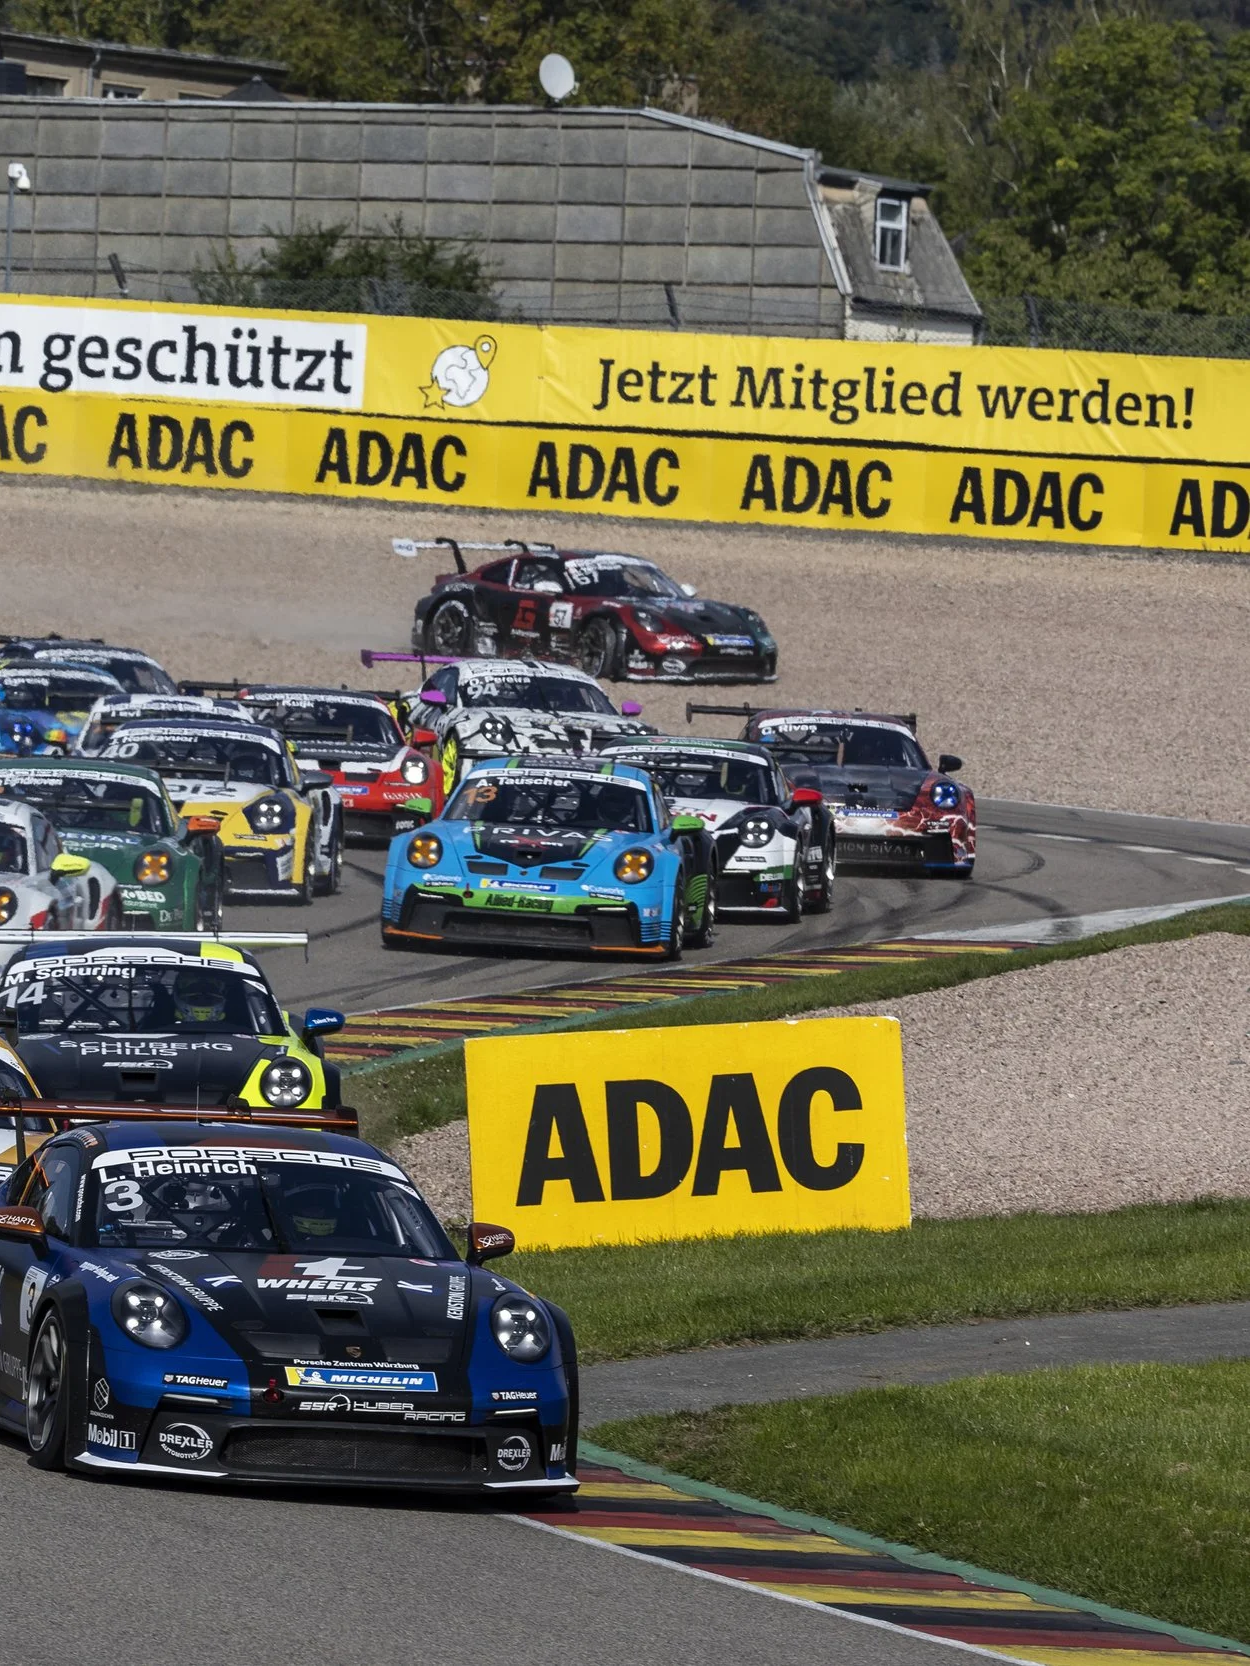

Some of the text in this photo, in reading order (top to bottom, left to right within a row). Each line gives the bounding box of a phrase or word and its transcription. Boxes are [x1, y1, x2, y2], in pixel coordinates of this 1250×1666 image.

[38, 325, 355, 395] geschützt
[593, 358, 1195, 430] Jetzt Mitglied werden!
[108, 412, 256, 479] ADAC
[315, 426, 467, 493] ADAC
[527, 440, 681, 507] ADAC
[740, 454, 894, 520] ADAC
[949, 466, 1105, 532] ADAC
[1169, 478, 1250, 539] AD
[466, 683, 500, 699] 94
[778, 724, 818, 734] Rivas
[617, 746, 751, 762] PORSCHE
[475, 776, 572, 788] A. Tauscher
[486, 769, 632, 786] PORSCHE
[463, 786, 498, 807] 13
[463, 825, 614, 843] PRIVAS
[33, 955, 235, 970] PORSCHE
[3, 964, 137, 988] M. Schuring
[0, 981, 48, 1009] 14
[59, 1040, 233, 1051] SCHUBERG
[81, 1047, 179, 1057] PHILIS
[516, 1066, 865, 1207] ADAC
[129, 1148, 383, 1172] PORSCHE
[99, 1159, 258, 1183] L. Heinrich
[104, 1179, 144, 1212] 3
[8, 1214, 36, 1227] HARTL
[256, 1278, 378, 1292] WHEELS
[184, 1285, 224, 1312] GRUPPE
[446, 1289, 465, 1321] KENSTON
[294, 1358, 420, 1370] Porsche Zentrum Würzburg
[330, 1373, 424, 1386] MICHELIN
[299, 1401, 414, 1412] SSR HUBER
[403, 1412, 466, 1423] RACING
[87, 1423, 118, 1447] Mobil
[159, 1432, 214, 1449] DREXLER
[160, 1443, 199, 1460] AUTOMOTIVE
[497, 1448, 531, 1460] DREXLER
